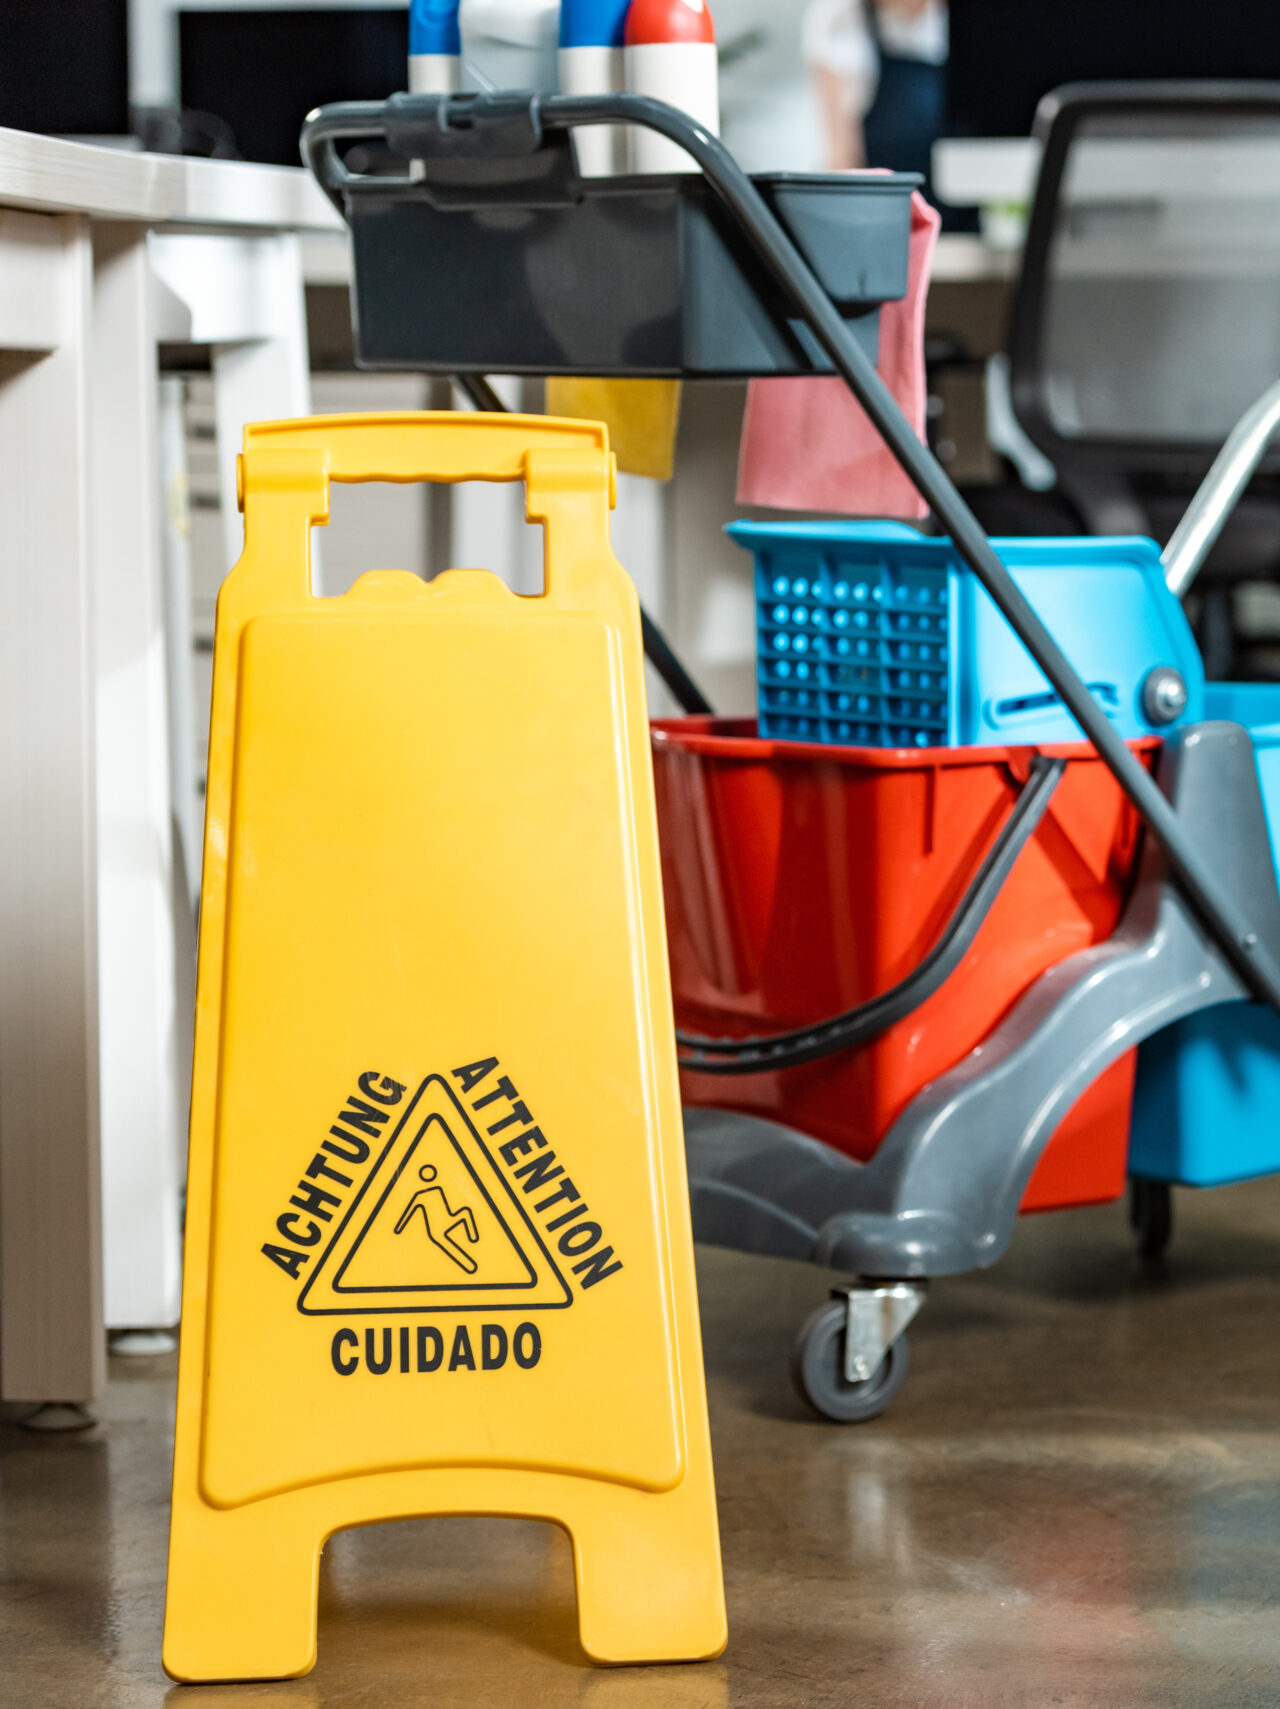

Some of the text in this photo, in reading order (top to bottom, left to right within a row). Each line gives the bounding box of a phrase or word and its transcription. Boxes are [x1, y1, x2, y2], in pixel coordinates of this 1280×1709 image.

[260, 1071, 407, 1280] ACHTUNG
[451, 1056, 623, 1290] ATTENTION
[331, 1322, 542, 1376] CUIDADO
